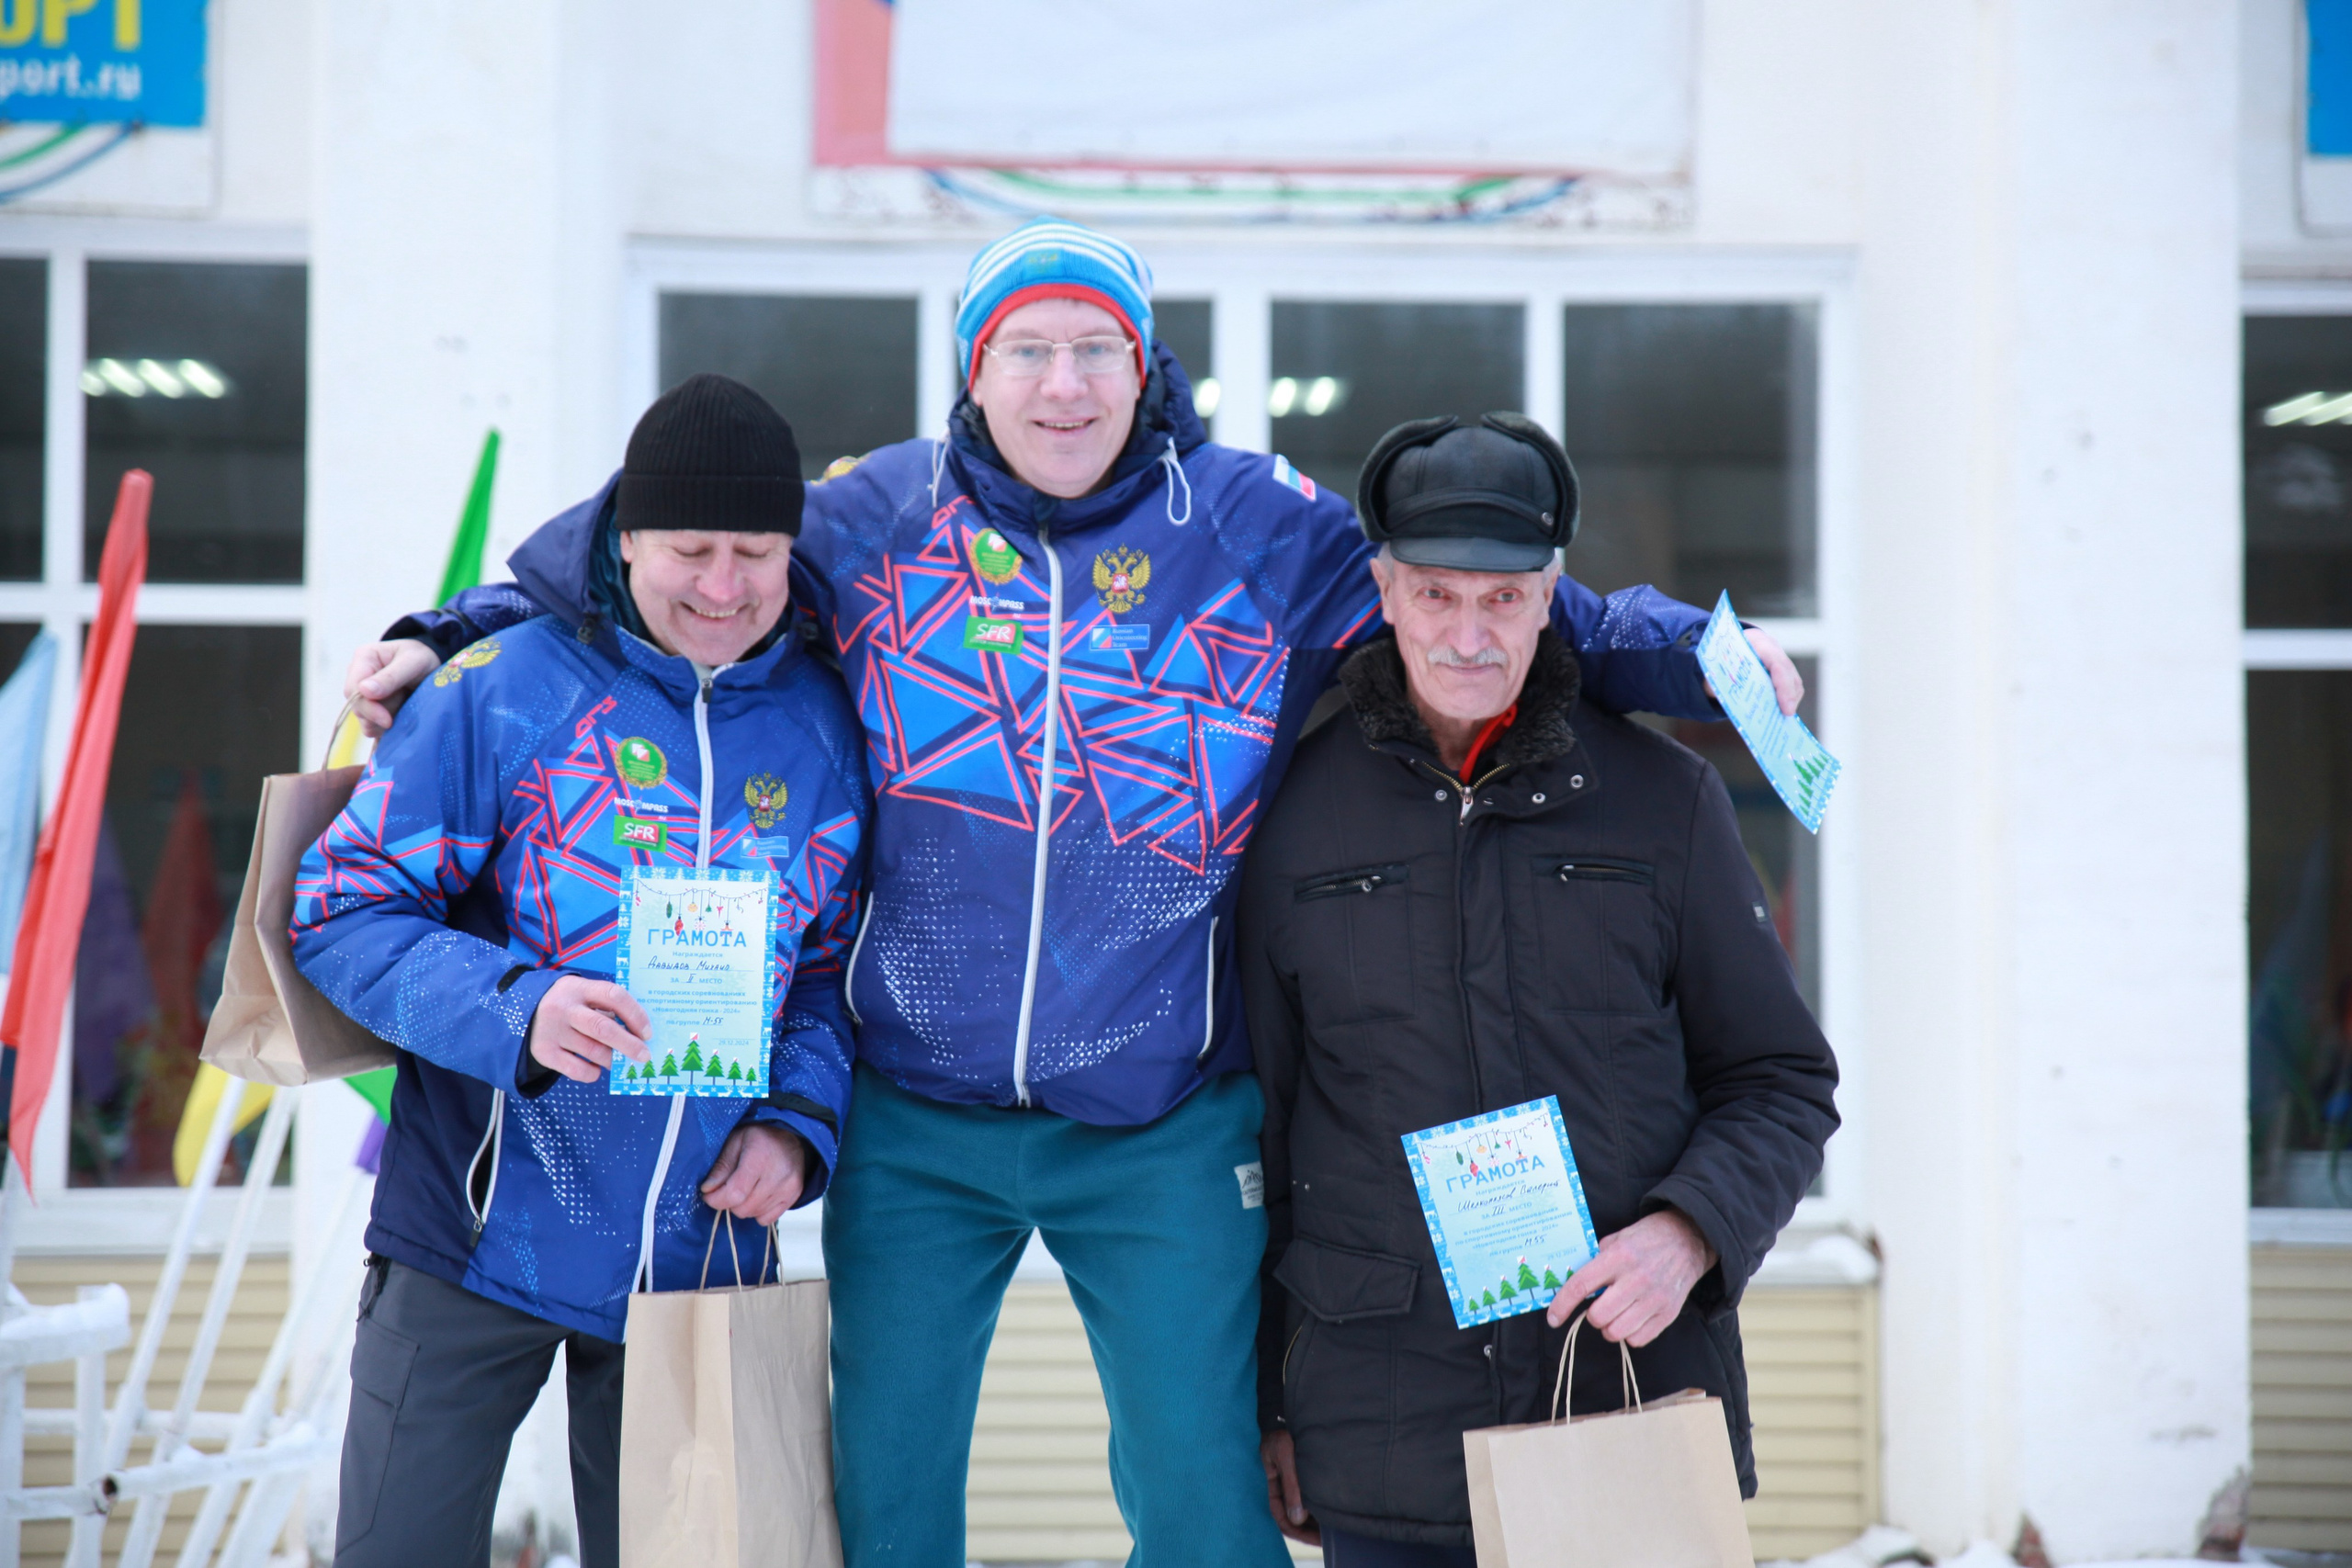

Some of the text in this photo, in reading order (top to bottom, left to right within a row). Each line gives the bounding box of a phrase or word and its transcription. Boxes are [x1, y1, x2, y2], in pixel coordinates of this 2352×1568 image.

[976, 623, 1011, 641] SFR
[624, 822, 655, 840] SFR
[647, 929, 747, 947] ГРАМОТА
[647, 998, 694, 1006] спортивному
[1445, 1155, 1545, 1193] ГРАМОТА
[1509, 1201, 1532, 1213] МЕСТО
